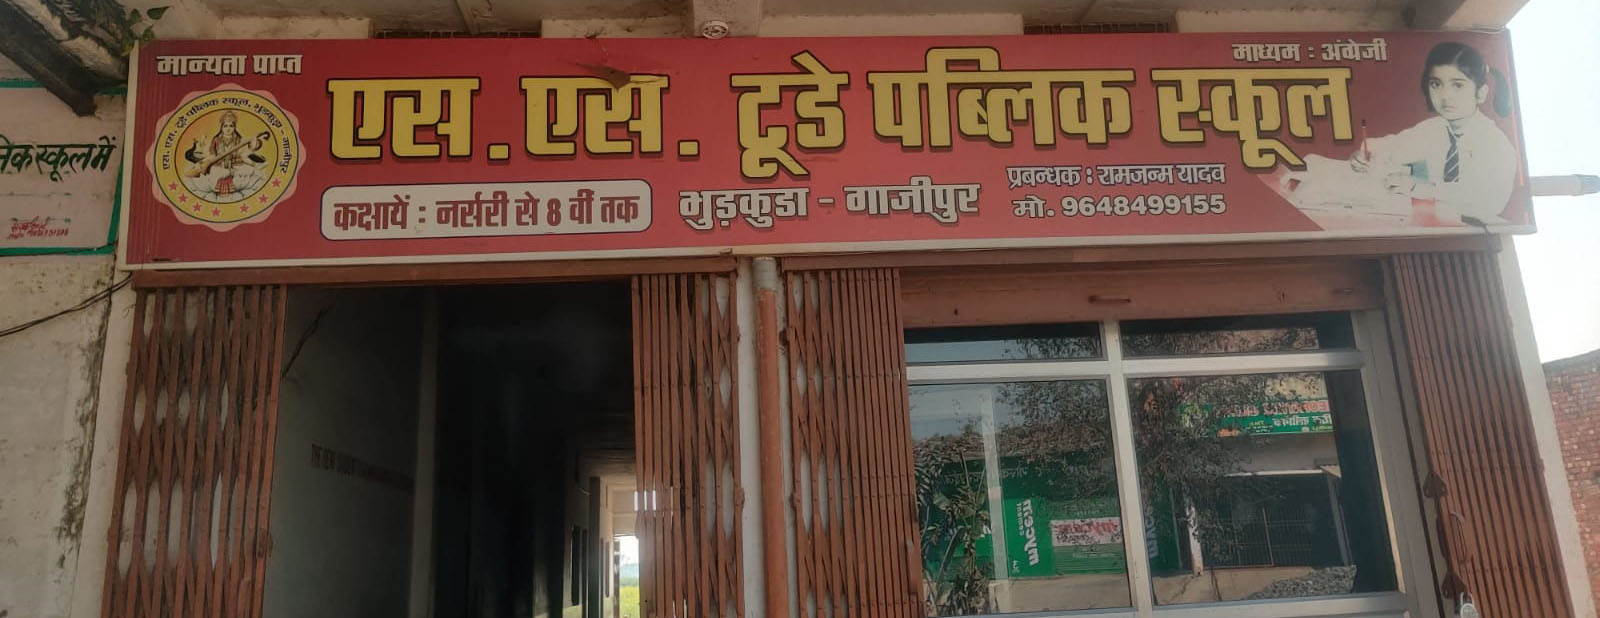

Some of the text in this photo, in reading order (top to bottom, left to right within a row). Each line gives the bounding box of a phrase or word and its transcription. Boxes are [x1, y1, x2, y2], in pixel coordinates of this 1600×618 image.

[156, 54, 303, 77] मान्यता प्राप्त
[1231, 42, 1300, 63] माध्यम
[1320, 37, 1388, 62] अंग्रेजी
[730, 50, 850, 180] टूडे
[867, 46, 1136, 150] पब्लिक
[1150, 66, 1355, 168] स्कूल
[35, 144, 96, 182] स्कूल
[91, 136, 117, 171] में
[1005, 165, 1083, 190] प्रबन्धक
[1096, 164, 1175, 185] रामजन्म
[1176, 162, 1227, 184] यादव
[333, 195, 411, 231] कक्षायें
[435, 190, 511, 229] नर्सरी
[514, 191, 542, 227] से
[546, 198, 562, 226] 8
[568, 188, 596, 225] वीं
[600, 196, 641, 224] तक
[843, 175, 983, 225] गाजीपुर
[1012, 194, 1227, 219] मो. 9648499155
